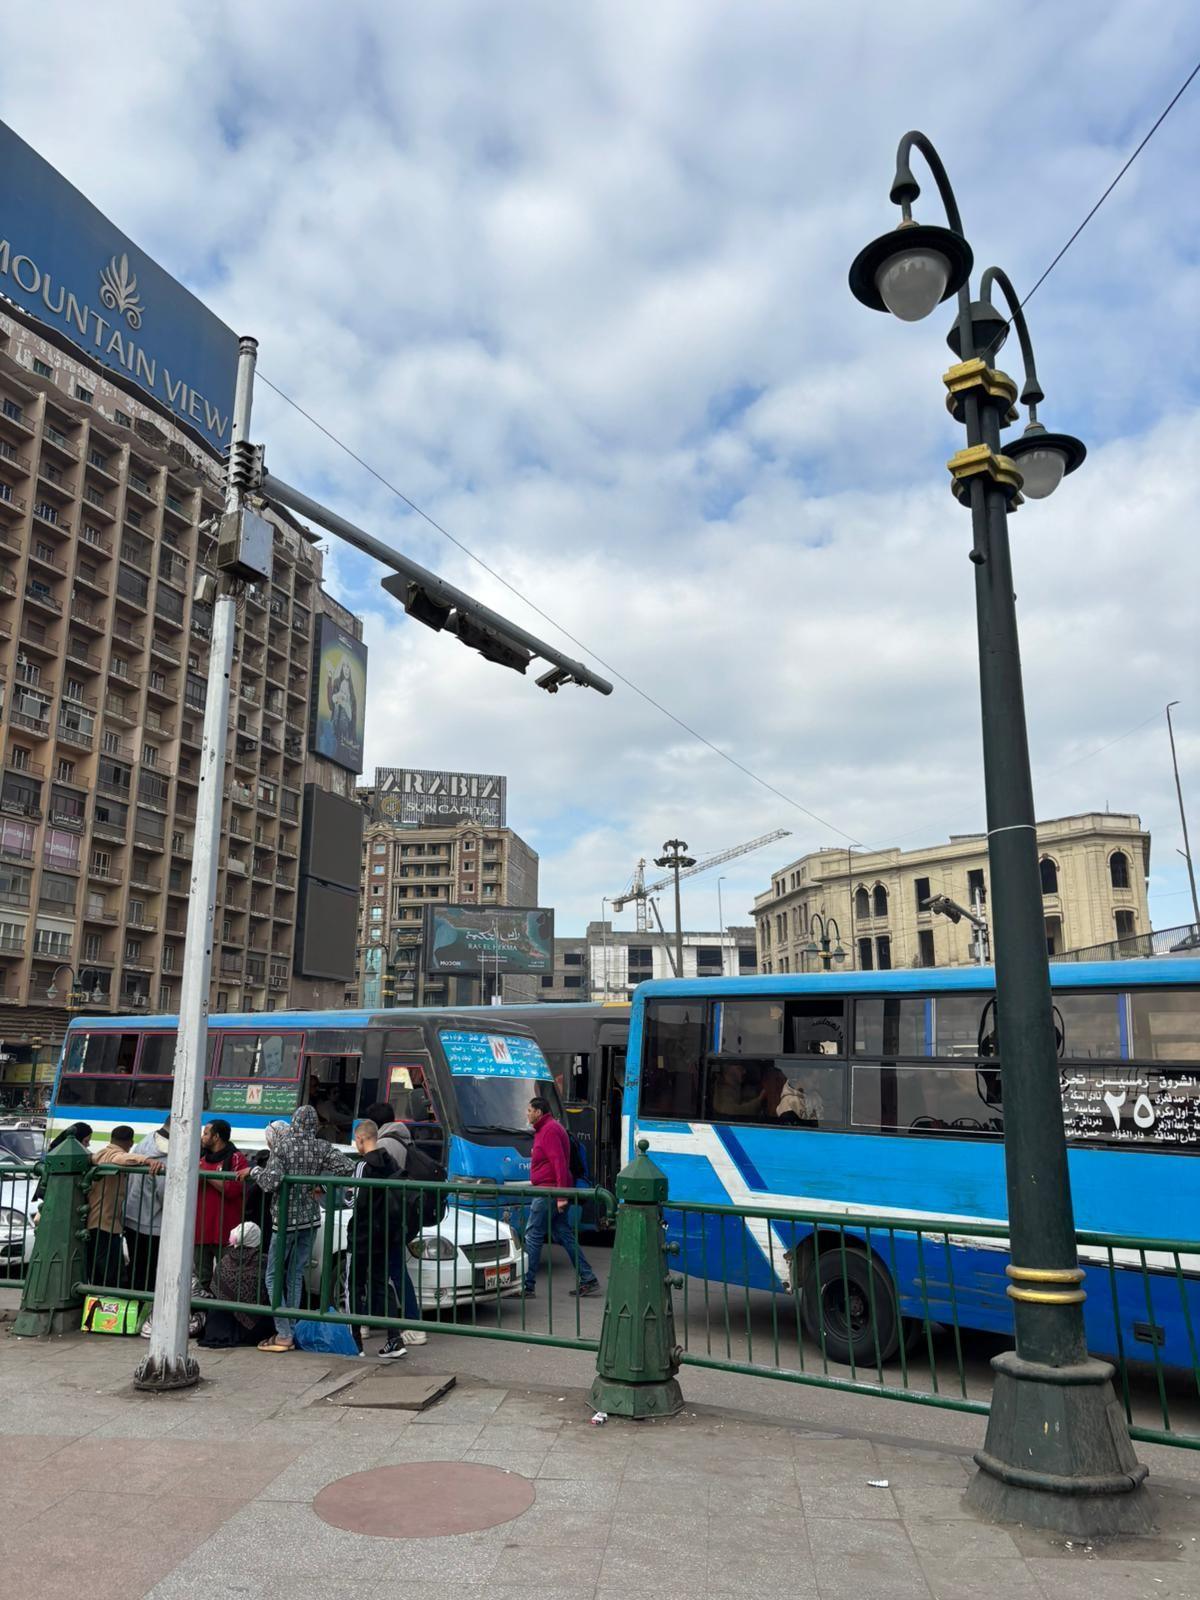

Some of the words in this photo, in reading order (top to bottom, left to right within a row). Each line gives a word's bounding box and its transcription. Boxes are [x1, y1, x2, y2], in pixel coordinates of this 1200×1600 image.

[163, 368, 229, 440] VIEW
[380, 772, 500, 799] ARABIA
[404, 801, 437, 814] SUN
[438, 804, 500, 817] CAPITAL
[1104, 1090, 1155, 1129] ٢٥
